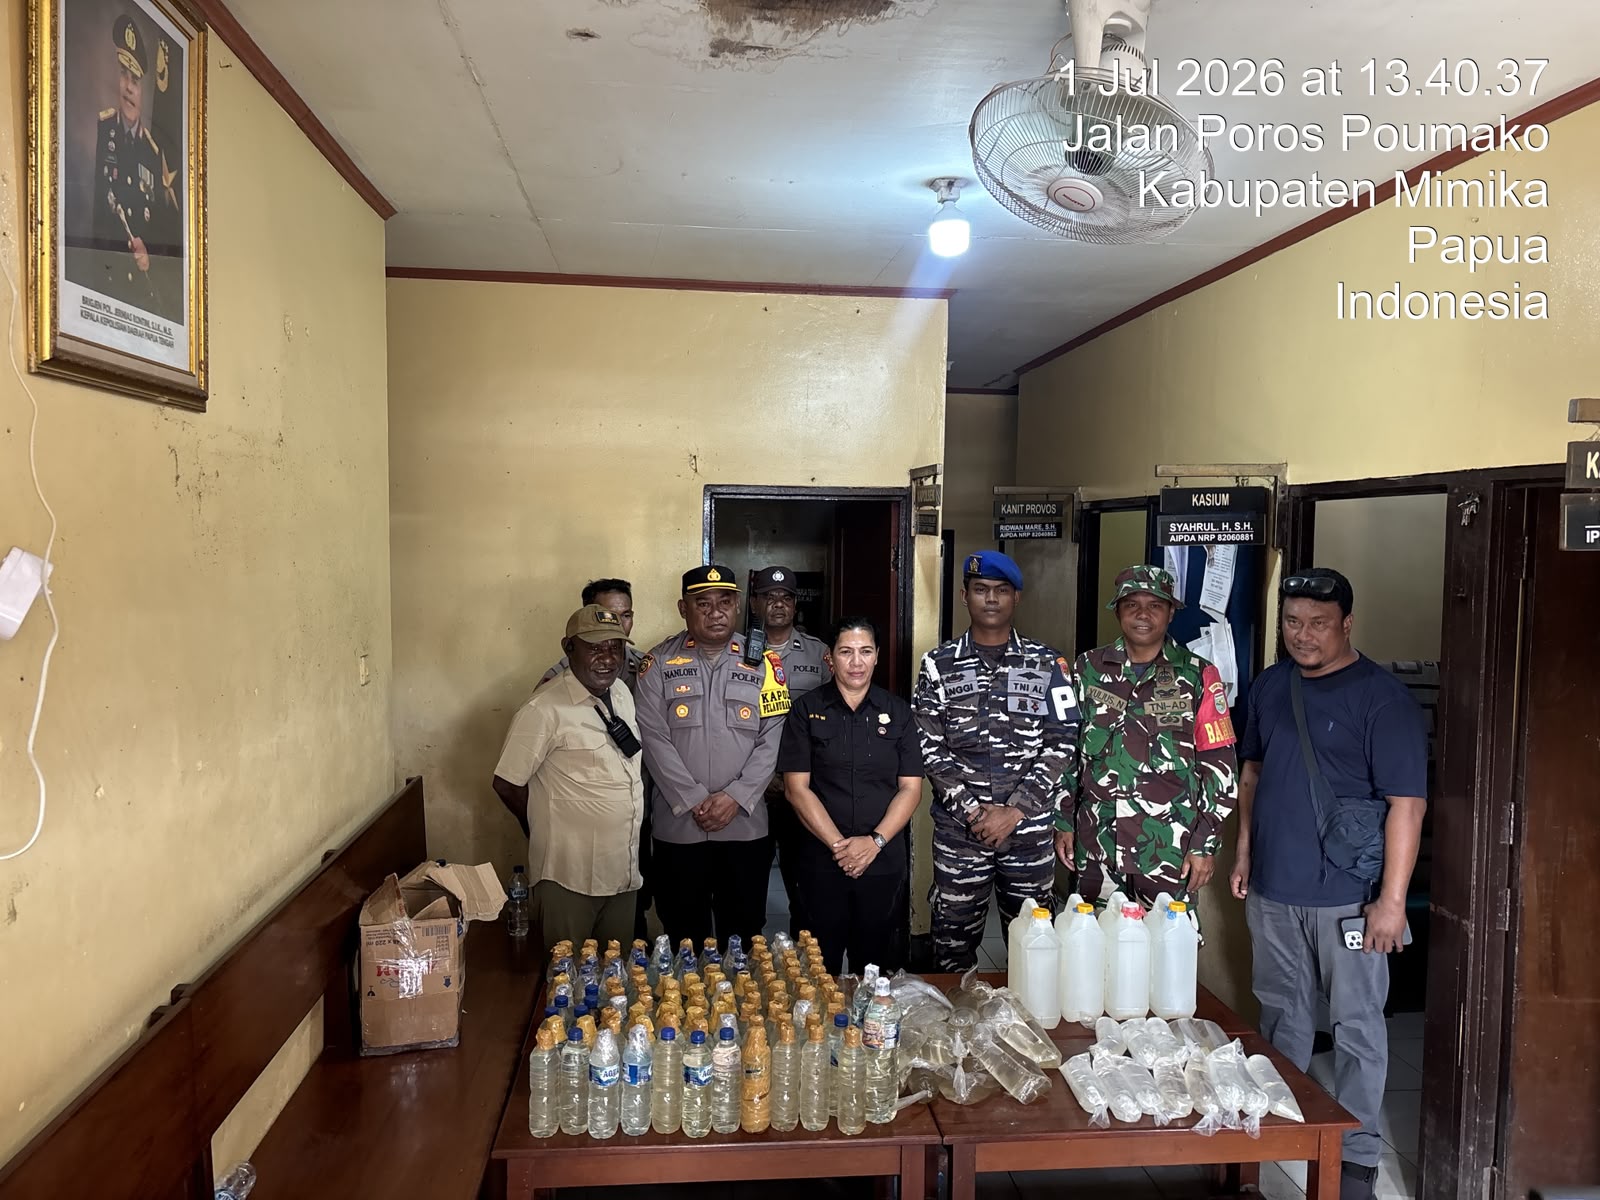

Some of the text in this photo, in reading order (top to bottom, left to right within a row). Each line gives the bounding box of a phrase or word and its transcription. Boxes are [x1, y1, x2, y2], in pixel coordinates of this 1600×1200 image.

[1586, 451, 1600, 479] K
[1192, 493, 1230, 507] KASIUM
[1001, 503, 1057, 515] KANIT PROVOS
[1169, 521, 1254, 532] SYAHRUL. H, S.H.
[1169, 533, 1254, 542] AIPDA NRP 82060881
[664, 668, 698, 680] NANLOHY
[793, 665, 819, 674] POLRI
[731, 672, 761, 685] POLRI
[1013, 682, 1043, 694] TNI AL
[1051, 686, 1077, 721] P
[1118, 700, 1125, 710] N
[1150, 701, 1187, 712] TNI-AD
